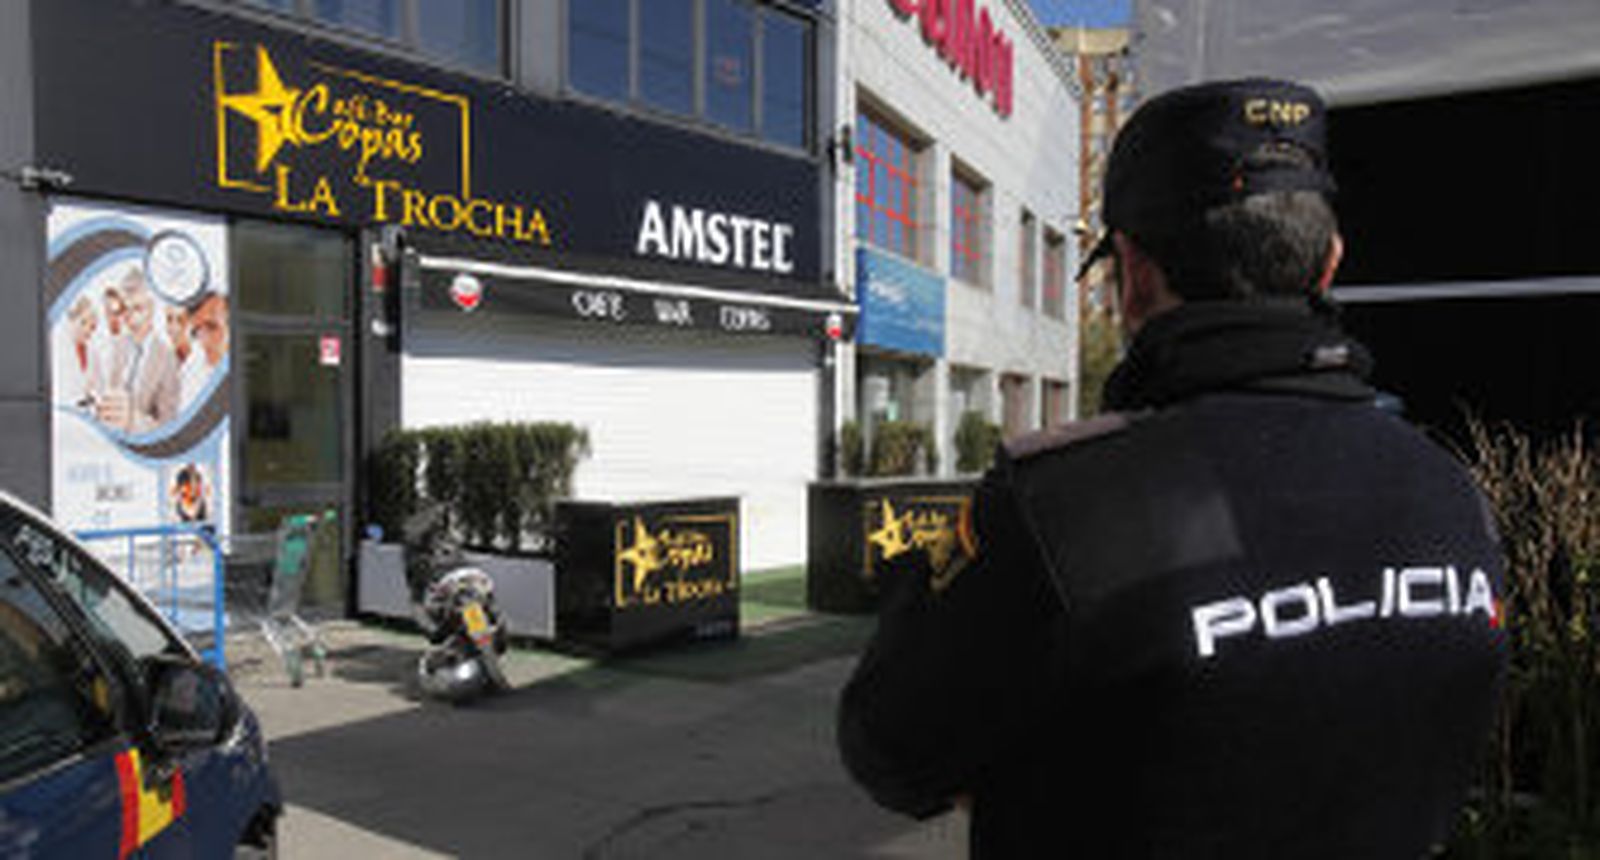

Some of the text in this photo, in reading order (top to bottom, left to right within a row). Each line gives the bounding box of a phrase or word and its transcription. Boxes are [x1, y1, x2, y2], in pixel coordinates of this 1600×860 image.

[296, 83, 422, 186] Copas
[1244, 98, 1311, 127] CNP
[274, 164, 551, 244] LA TROCHA
[1191, 564, 1498, 657] POLICIA
